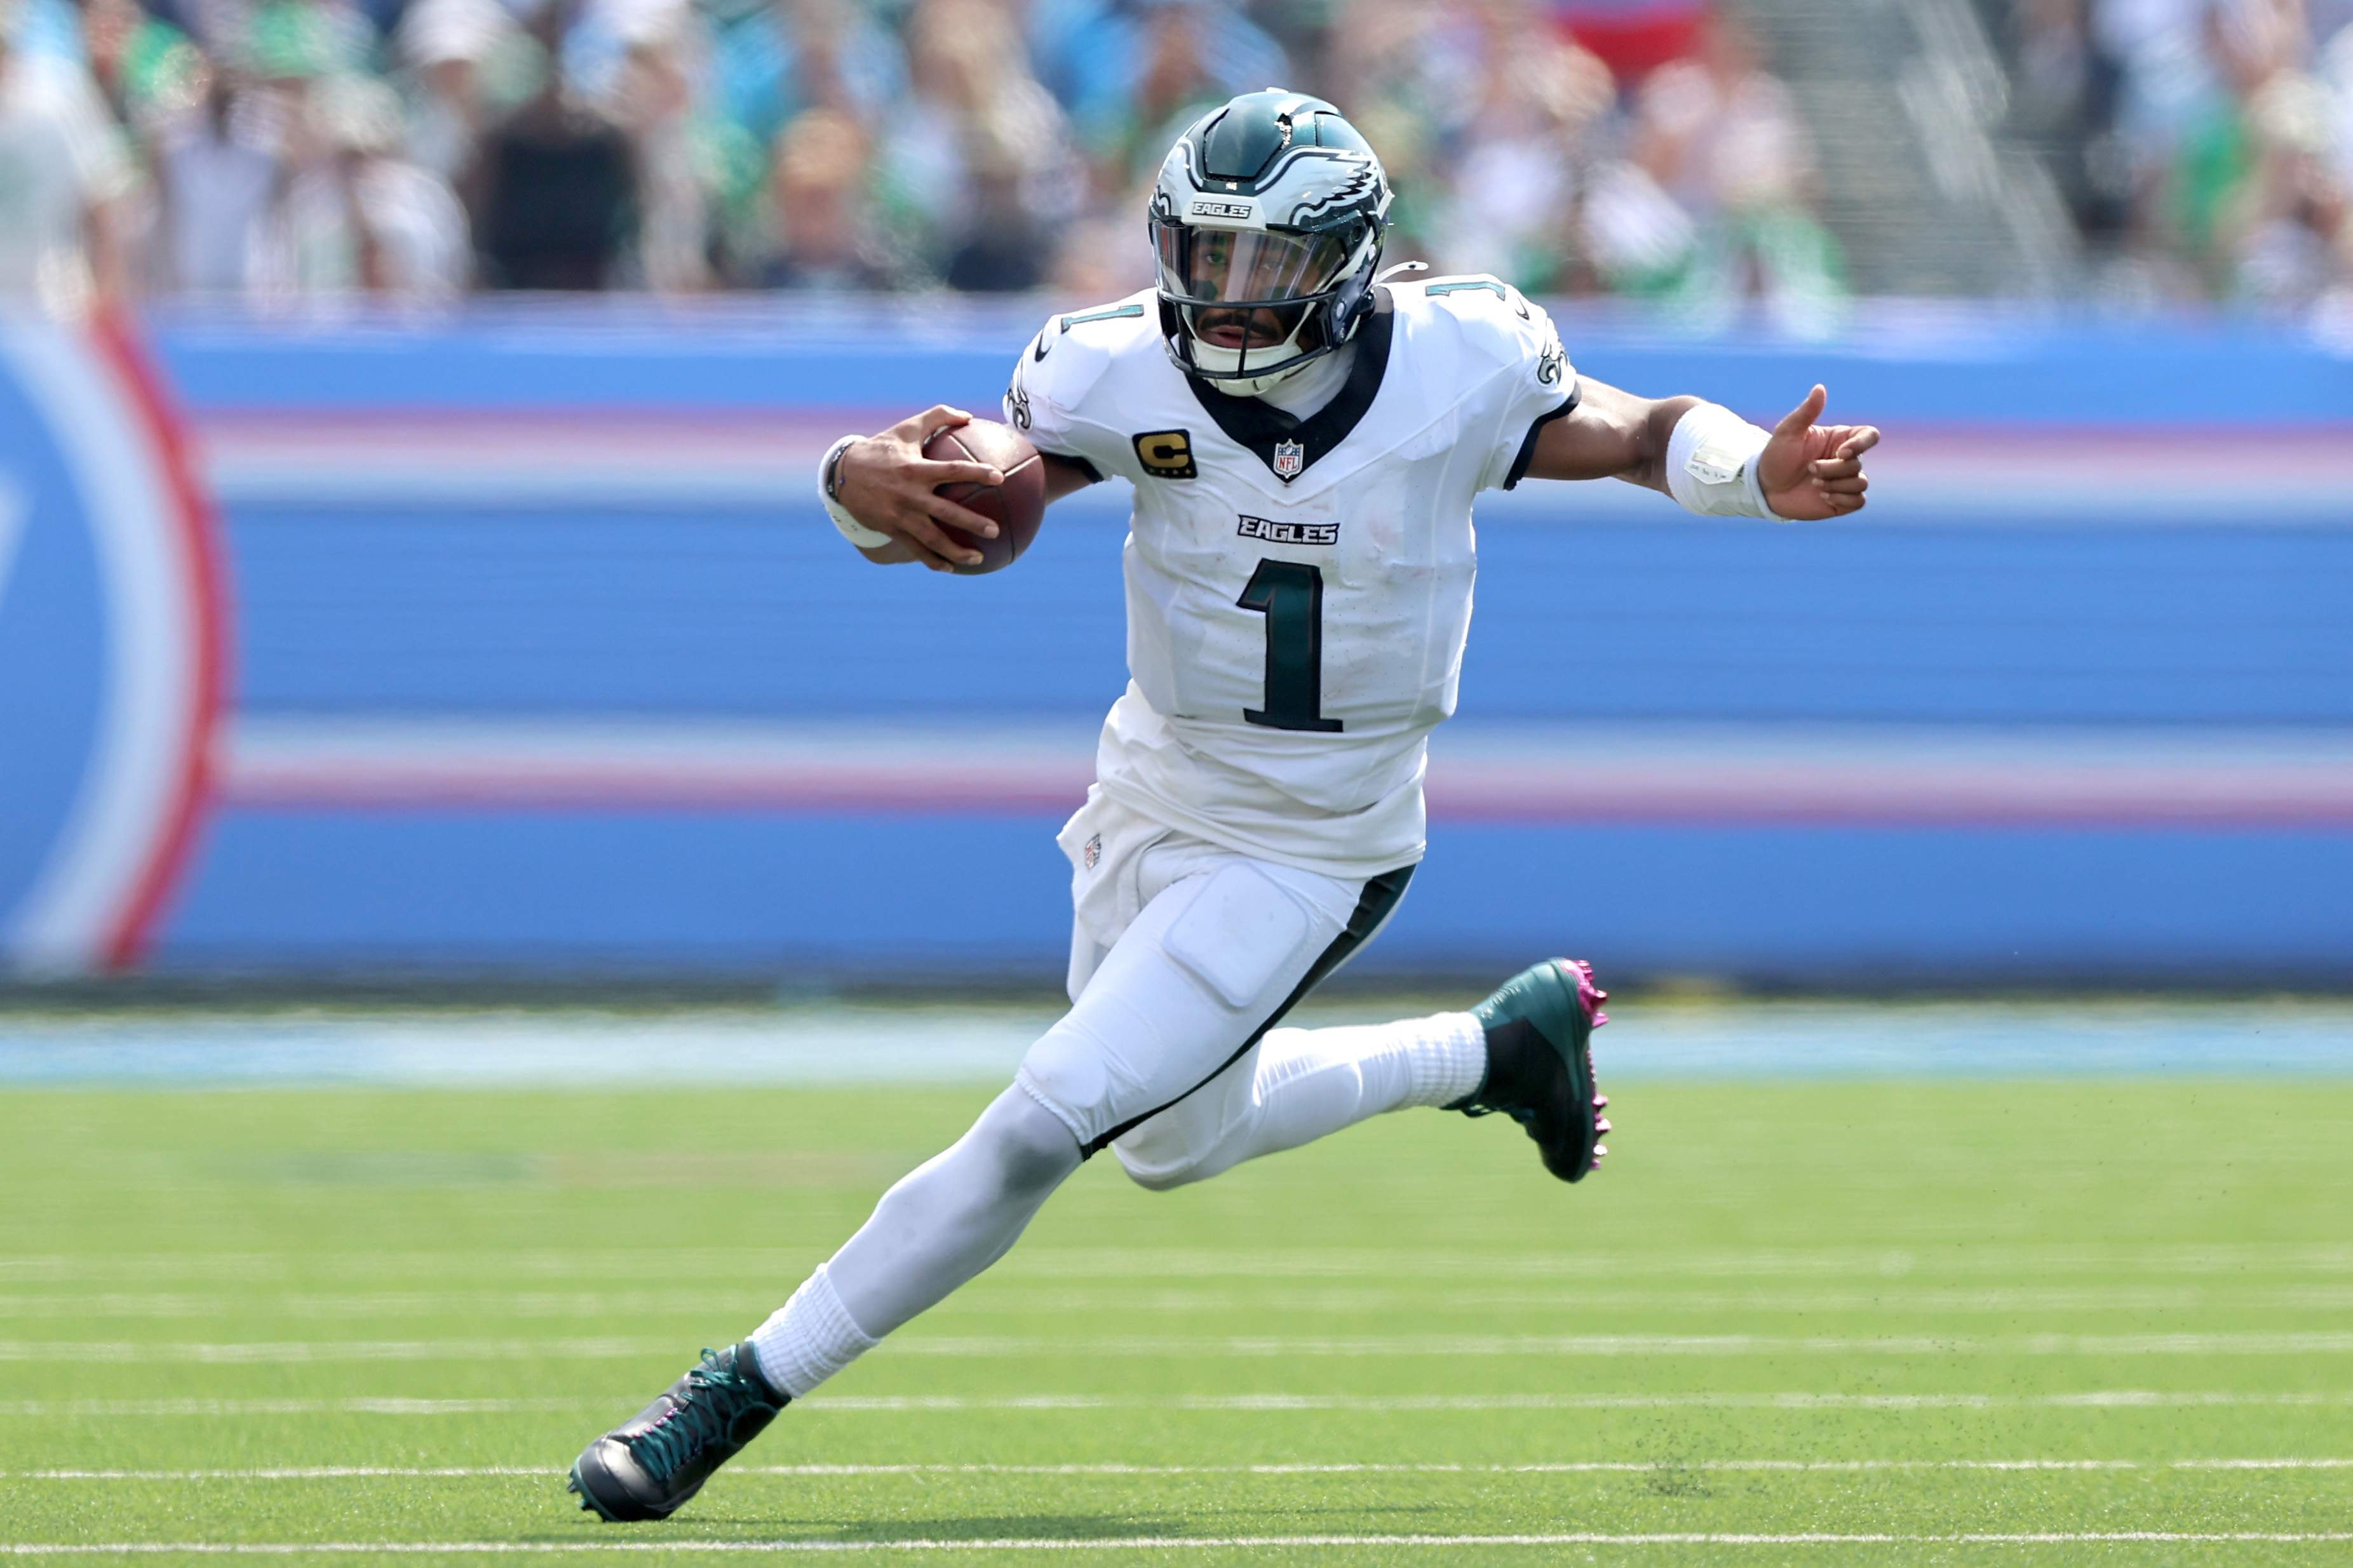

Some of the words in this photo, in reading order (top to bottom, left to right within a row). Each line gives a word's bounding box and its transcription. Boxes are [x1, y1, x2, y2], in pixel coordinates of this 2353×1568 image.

[1192, 202, 1251, 218] EAGLES
[1425, 281, 1506, 302] 1
[1060, 304, 1144, 334] 1
[1138, 433, 1189, 468] C
[1279, 457, 1297, 470] NFL
[1237, 514, 1340, 545] EAGLES
[1236, 558, 1344, 732] 1
